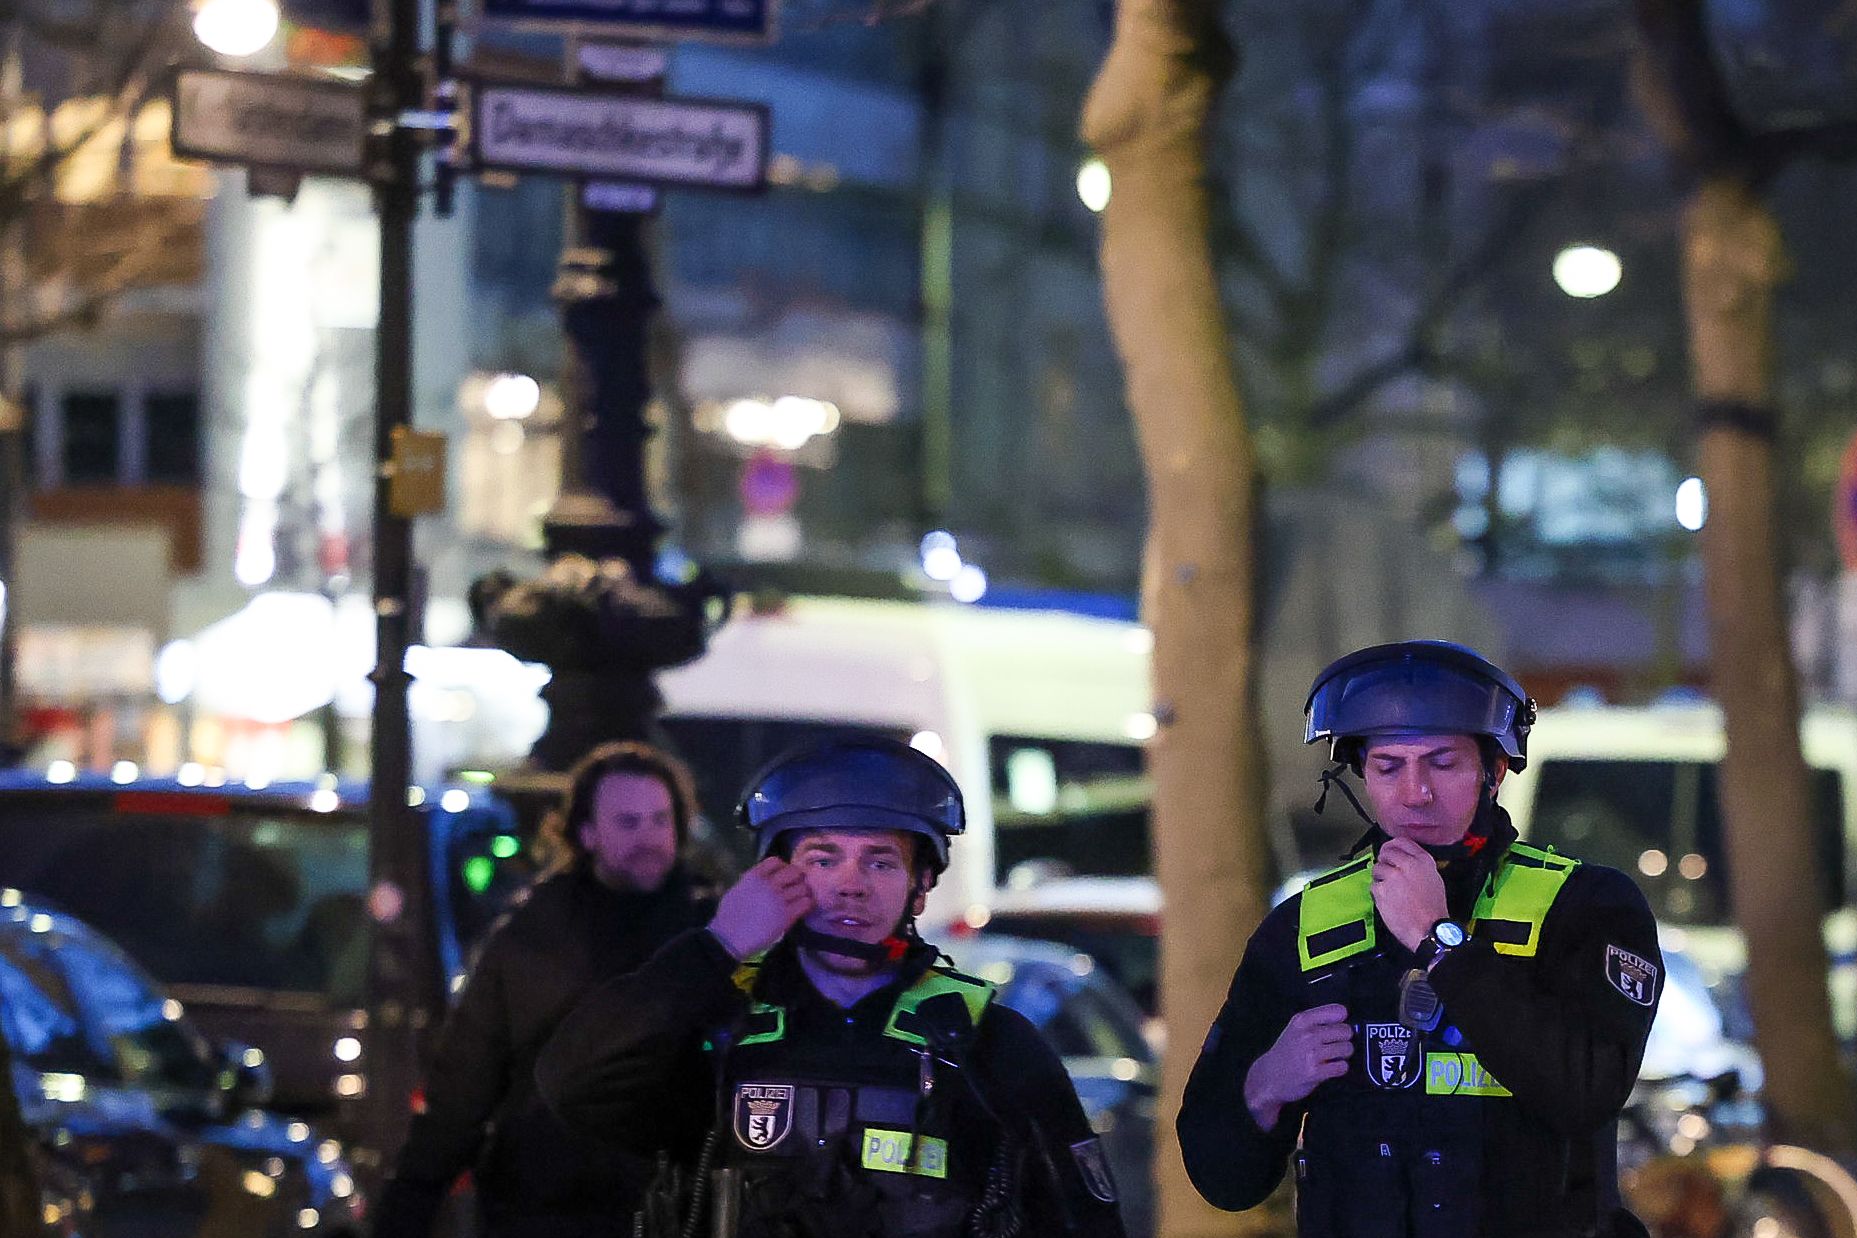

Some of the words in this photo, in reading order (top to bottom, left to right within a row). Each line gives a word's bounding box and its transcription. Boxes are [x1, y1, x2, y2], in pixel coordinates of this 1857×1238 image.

[1609, 948, 1655, 977] POLIZEI
[1369, 1027, 1412, 1039] POLIZE
[741, 1087, 789, 1100] POLIZEI
